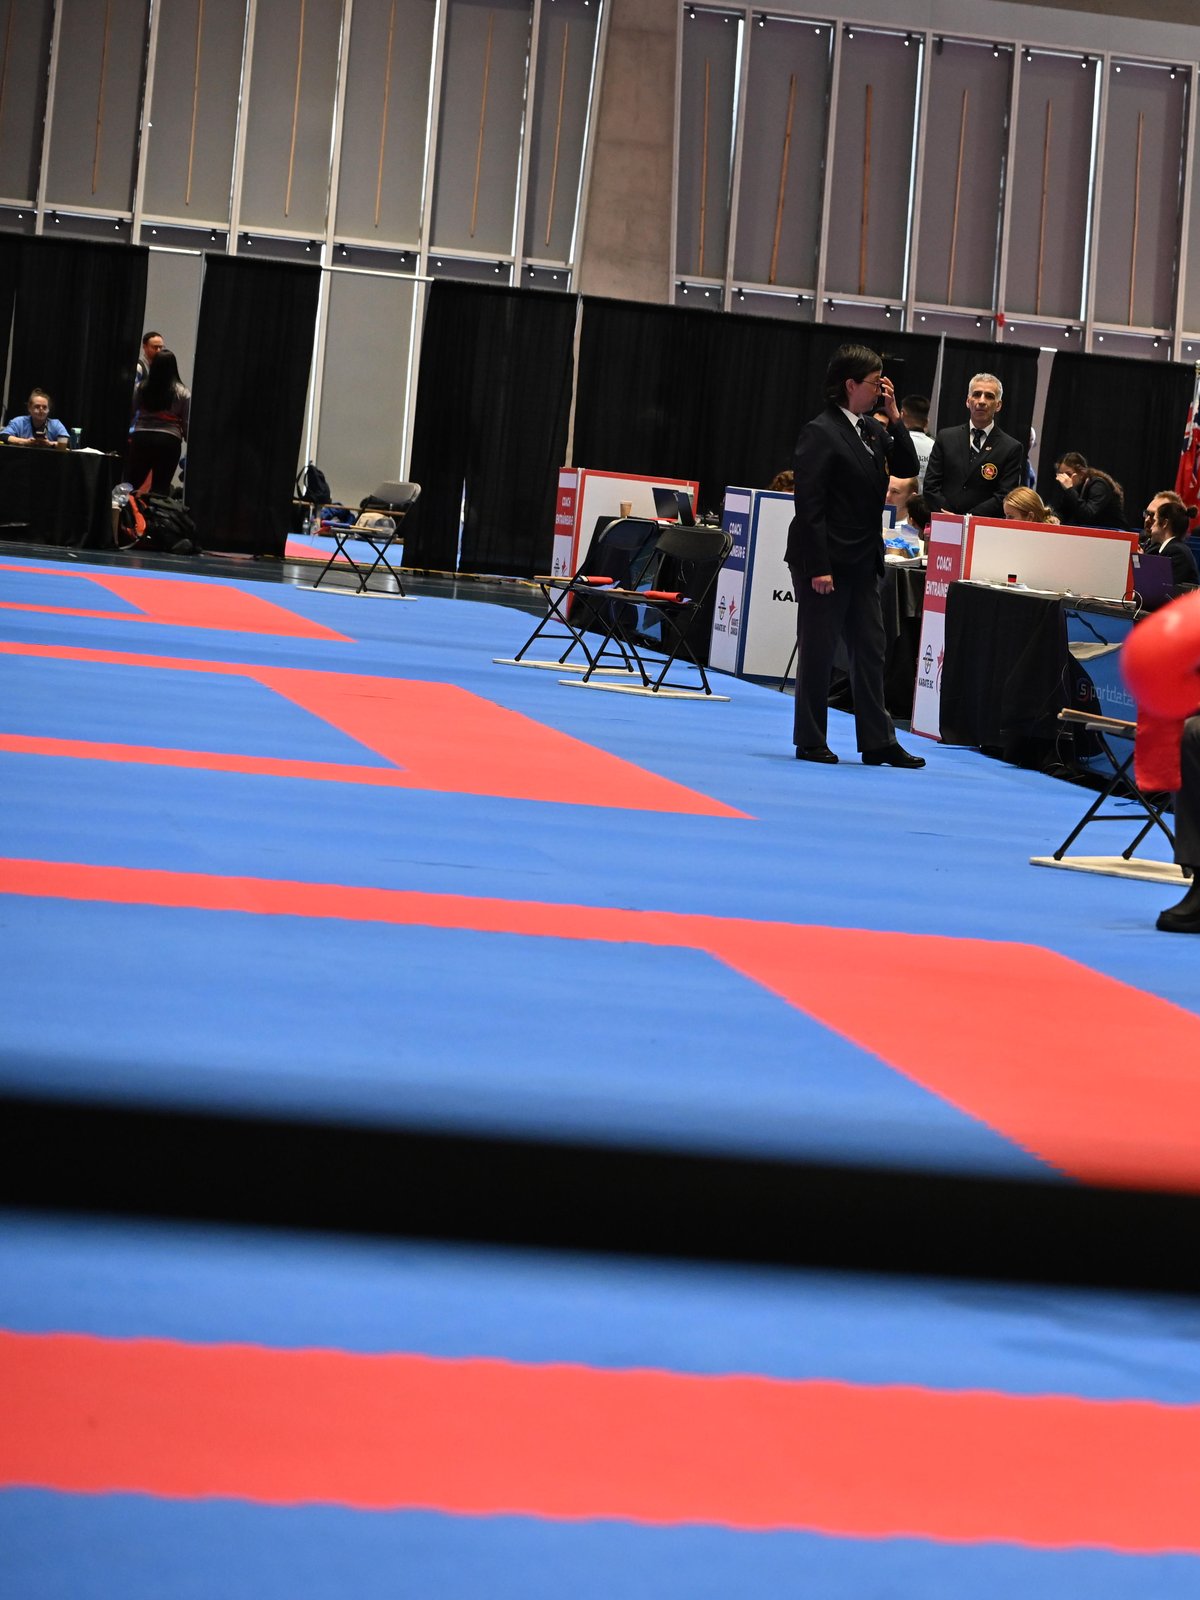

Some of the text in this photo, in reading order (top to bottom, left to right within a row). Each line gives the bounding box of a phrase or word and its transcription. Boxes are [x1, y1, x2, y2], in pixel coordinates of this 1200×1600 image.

[729, 522, 742, 536] COACH
[936, 555, 952, 571] COACH
[918, 677, 929, 688] KARATE
